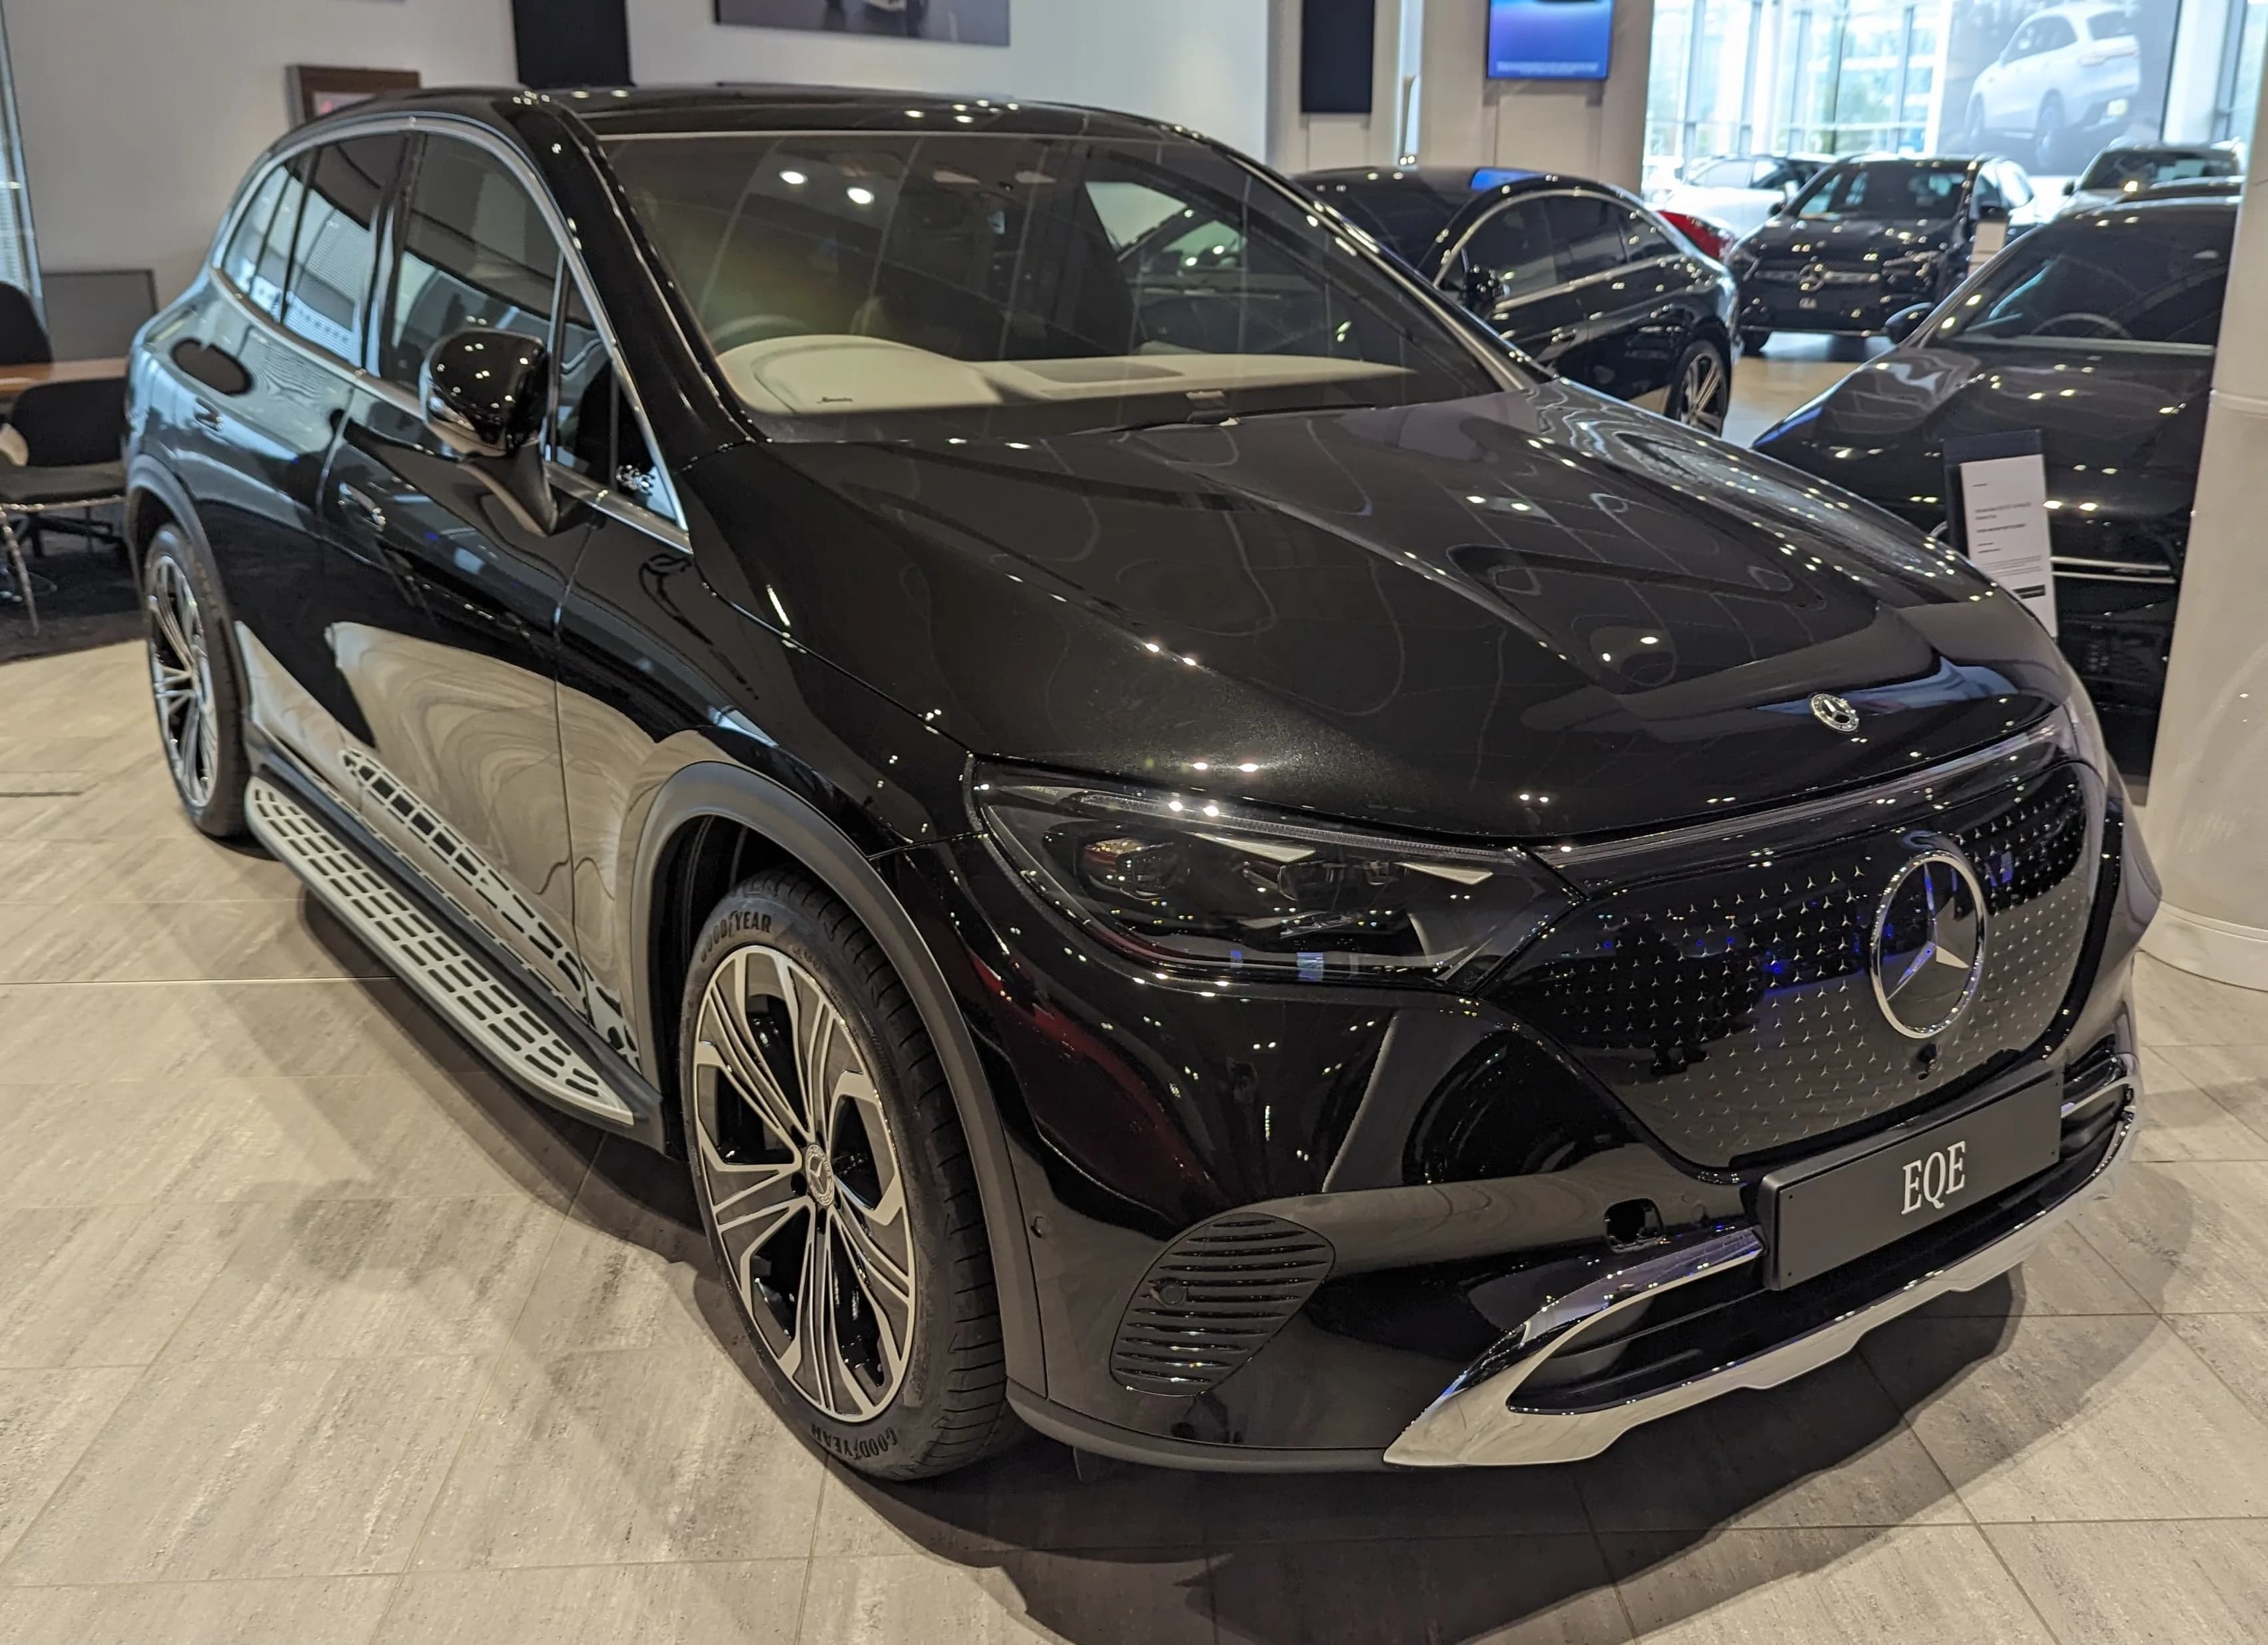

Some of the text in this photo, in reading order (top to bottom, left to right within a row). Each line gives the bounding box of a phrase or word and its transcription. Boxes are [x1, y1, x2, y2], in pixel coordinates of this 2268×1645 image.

[701, 910, 771, 963] GOODYEAR
[1901, 1141, 1966, 1215] EQE
[811, 1423, 897, 1460] GOODYEAR
